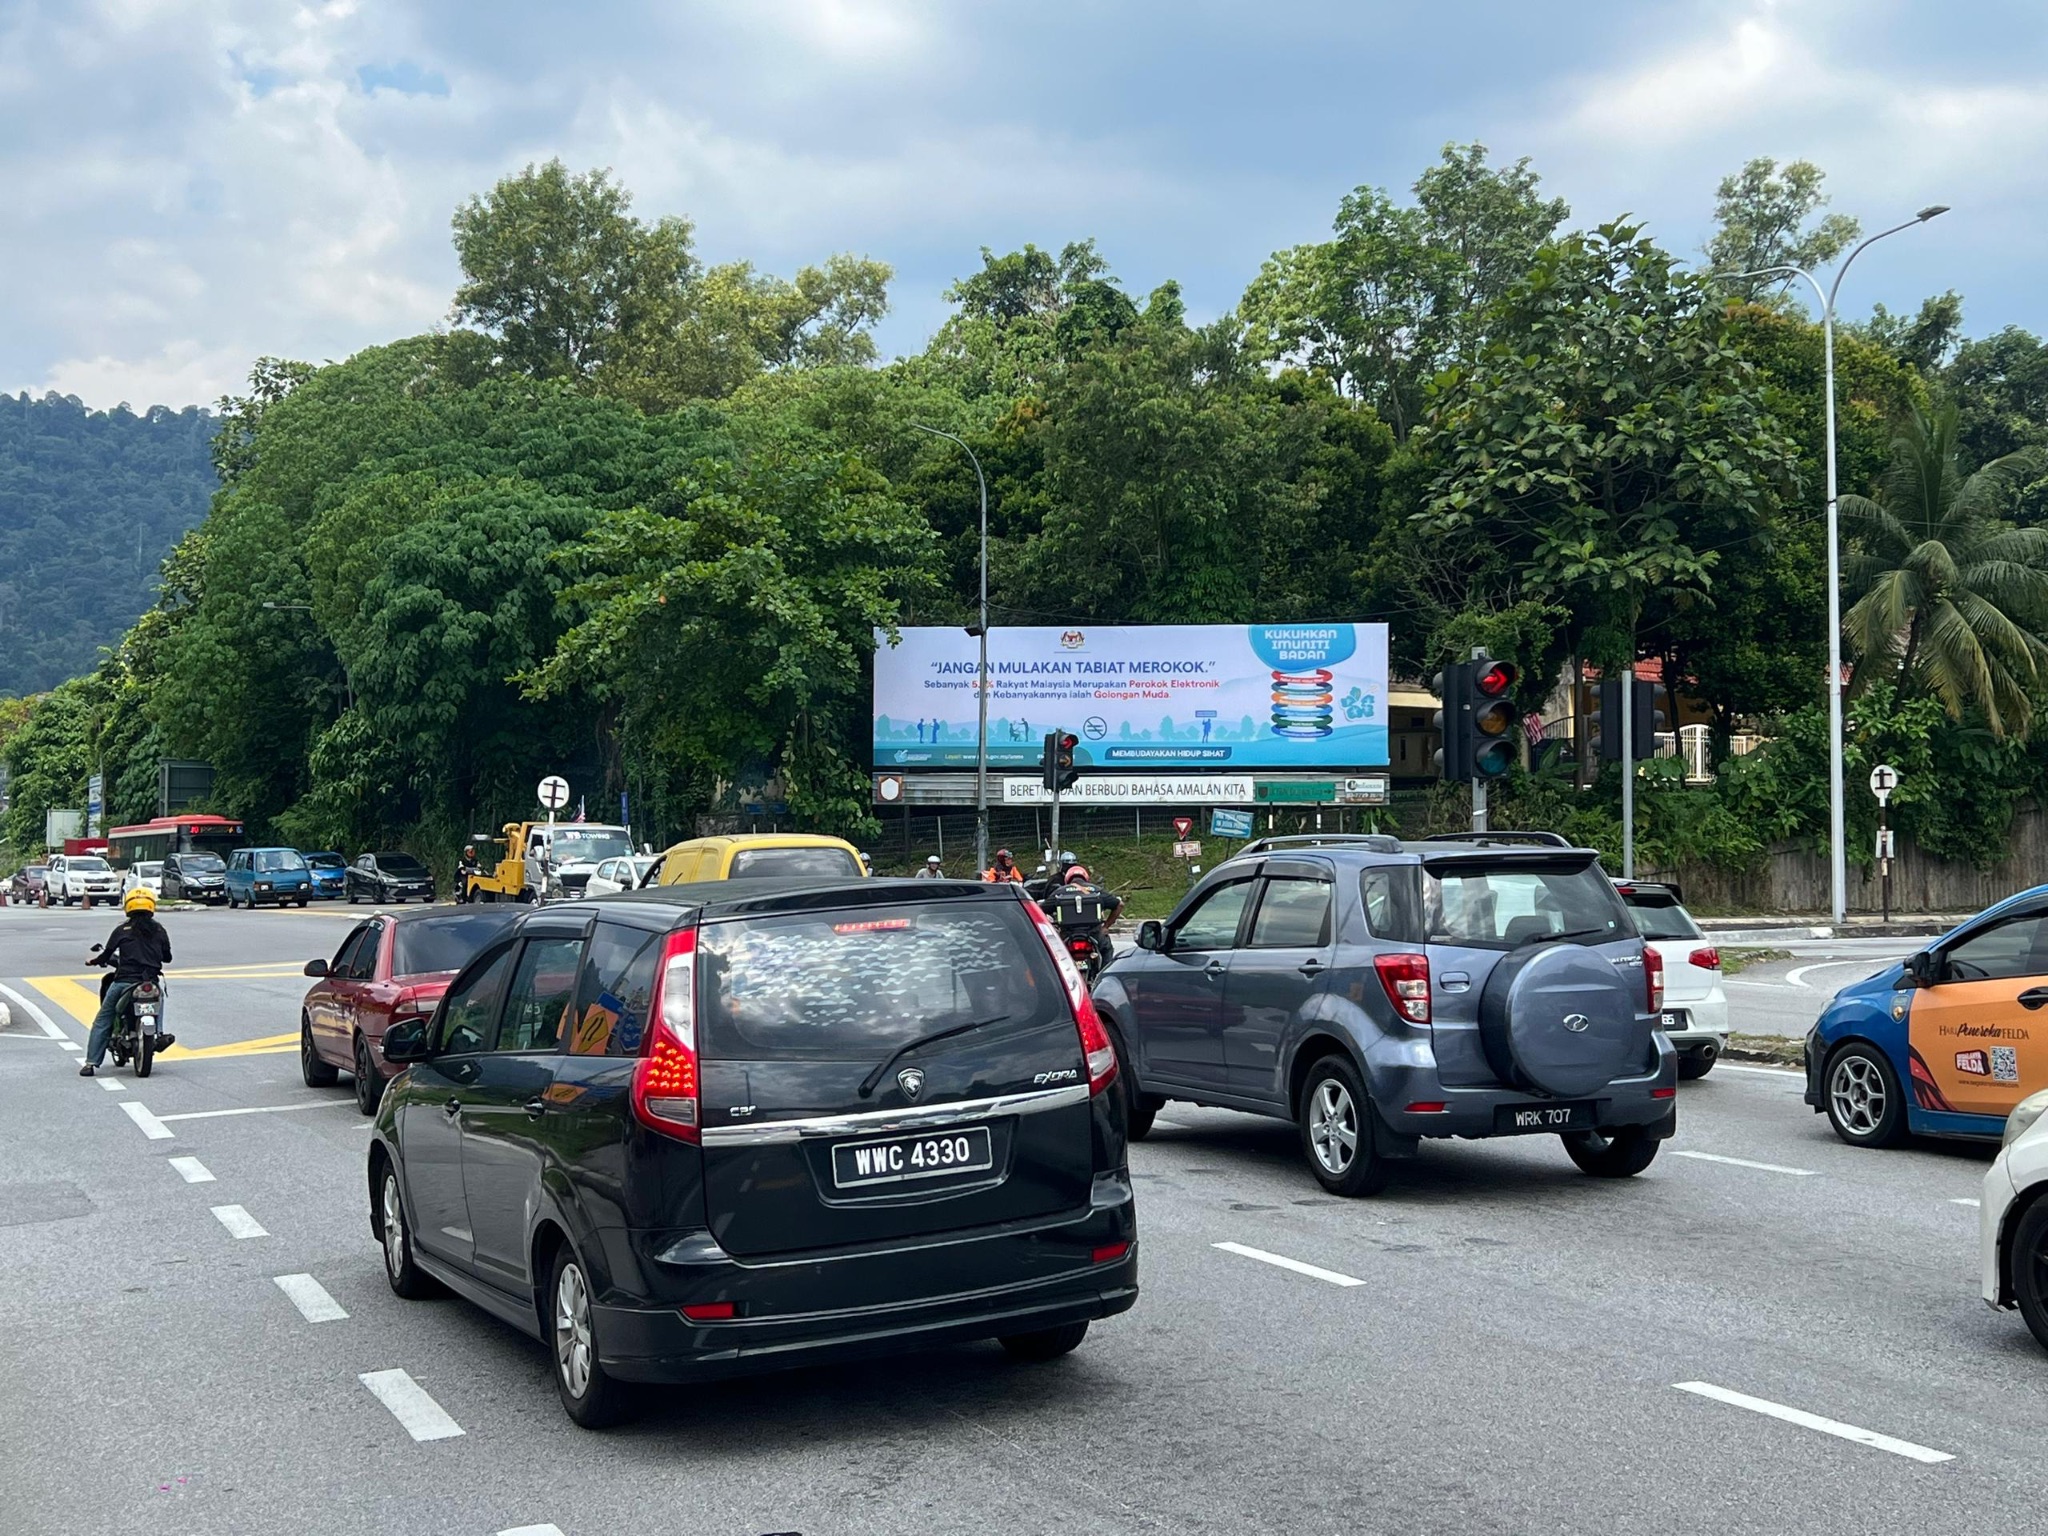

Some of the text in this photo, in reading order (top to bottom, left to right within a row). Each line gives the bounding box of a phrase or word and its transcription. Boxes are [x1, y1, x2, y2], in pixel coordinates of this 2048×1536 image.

[1264, 629, 1337, 639] KUKUHKAN
[1271, 640, 1330, 650] IMUNITI
[1279, 650, 1326, 660] BADAN
[998, 662, 1072, 674] MULAKAN
[1075, 662, 1125, 674] TABIAT
[924, 680, 969, 690] Sebanyak
[996, 680, 1029, 690] Rakyat
[1030, 680, 1071, 690] Malaysia
[1073, 680, 1126, 690] Merupakan
[1128, 679, 1168, 689] Perokok
[1171, 679, 1220, 689] Elektronik
[974, 691, 991, 699] dn
[993, 690, 1067, 700] Kebanyakannya
[1094, 690, 1140, 700] Golongan
[1142, 690, 1171, 699] Muda.
[1112, 749, 1225, 757] MEMBUDAYAKAN HIDUP SIHAT
[1085, 783, 1129, 796] BERBUDI
[1131, 783, 1173, 796] BAHASA
[1177, 783, 1221, 796] AMALAN
[1223, 783, 1246, 796] KITA
[2002, 1028, 2030, 1040] FELDA
[1957, 1059, 1985, 1075] FELDA
[1033, 1068, 1078, 1085] EXORA
[1515, 1109, 1571, 1127] WRK 707
[855, 1137, 970, 1176] WWC 4330
